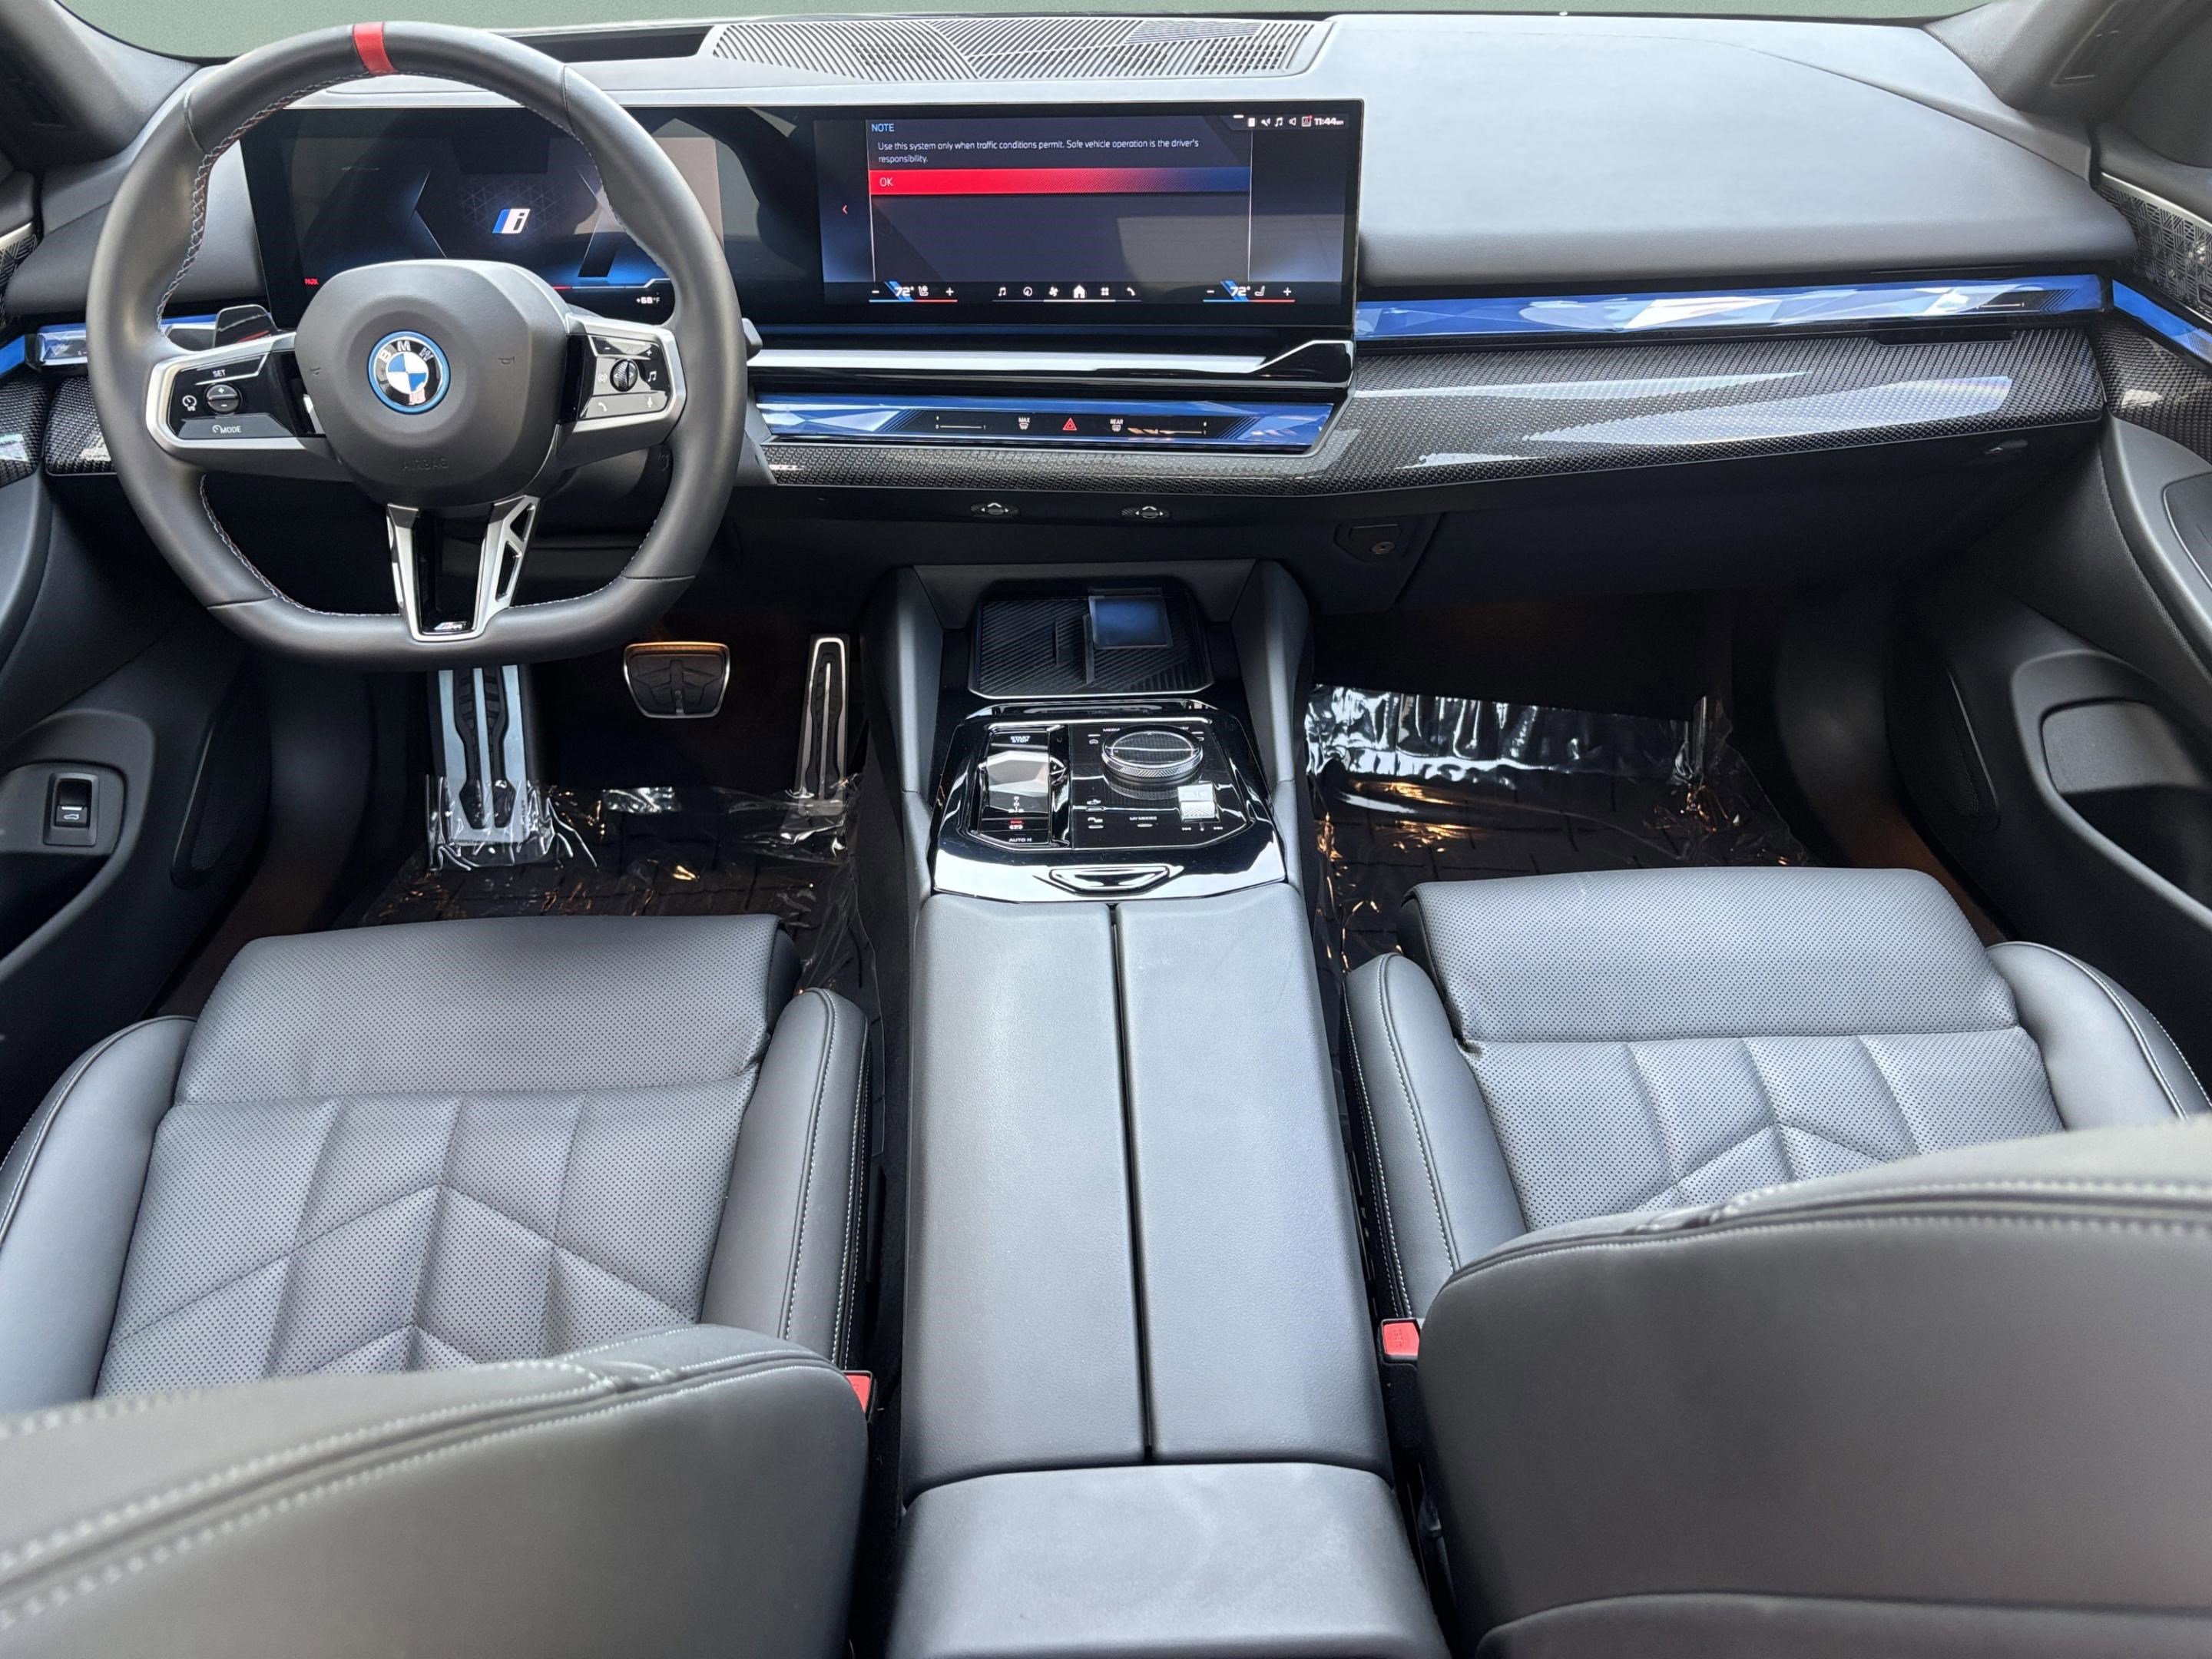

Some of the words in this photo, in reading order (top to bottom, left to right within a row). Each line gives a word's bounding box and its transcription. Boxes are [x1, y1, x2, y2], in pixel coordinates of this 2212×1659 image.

[871, 123, 895, 132] NOTE
[877, 141, 892, 151] Use
[894, 141, 908, 151] this
[909, 142, 936, 151] system
[938, 141, 953, 151] only
[955, 141, 975, 150] when
[976, 141, 998, 150] traffic
[998, 141, 1037, 149] conditions
[1038, 140, 1065, 150] permit.
[1066, 139, 1084, 148] Safe
[1084, 139, 1111, 148] vehicle
[1112, 139, 1148, 149] operation
[1149, 139, 1156, 147] is
[1157, 138, 1170, 147] the
[1171, 138, 1199, 147] driver's
[878, 154, 929, 164] responsibility.
[879, 177, 893, 187] OK
[378, 339, 435, 363] BMW
[220, 426, 242, 434] MODE
